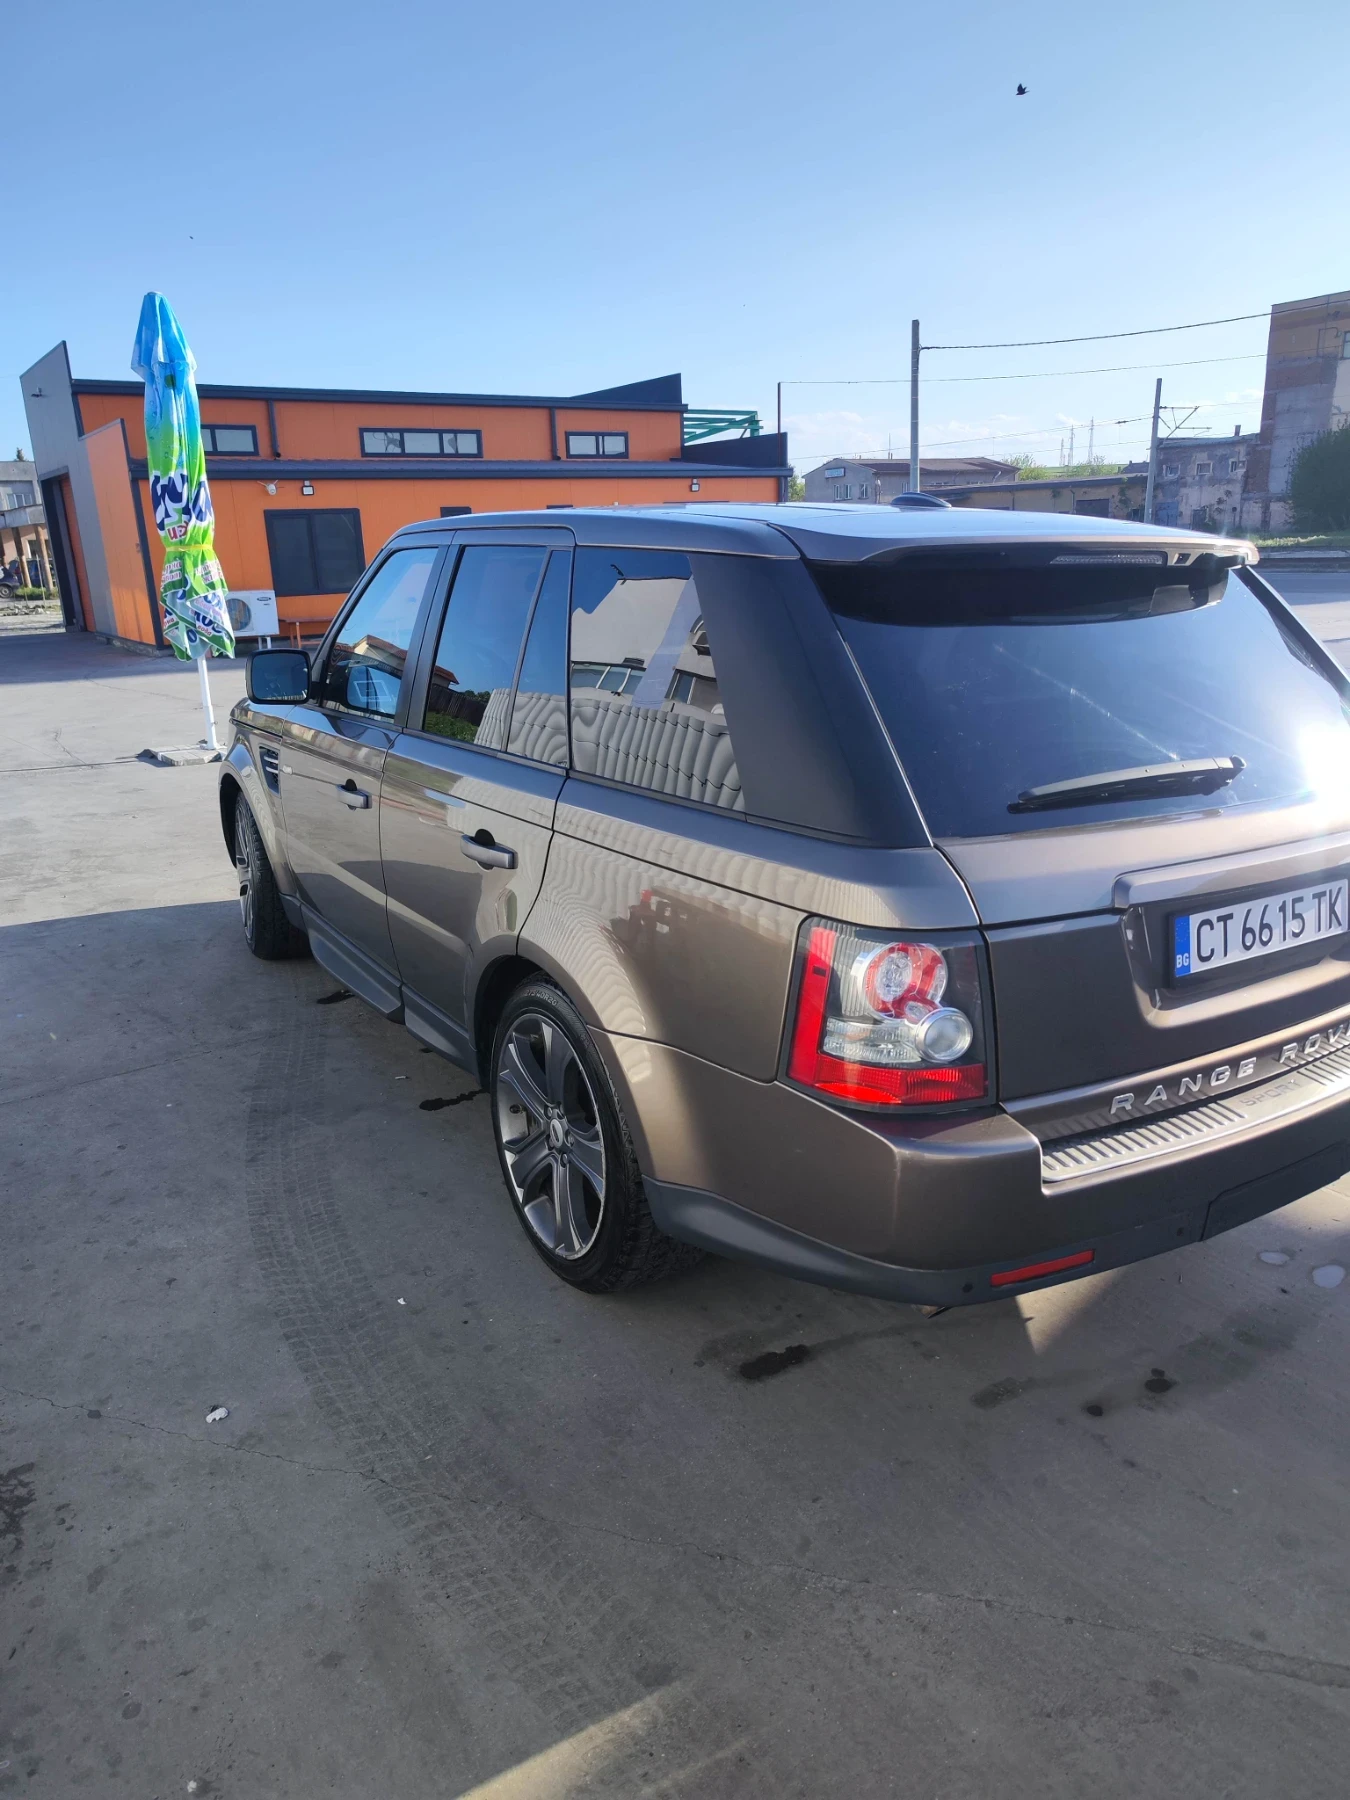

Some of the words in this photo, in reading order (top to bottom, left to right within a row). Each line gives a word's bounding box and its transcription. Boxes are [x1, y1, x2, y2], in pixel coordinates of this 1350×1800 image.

[1196, 913, 1234, 963] CT
[1241, 896, 1306, 951] 6615
[1312, 886, 1343, 933] TK
[1176, 952, 1189, 968] BG
[1110, 1056, 1257, 1115] RANGE
[1279, 1020, 1350, 1064] ROV
[1239, 1079, 1302, 1107] SPORT
